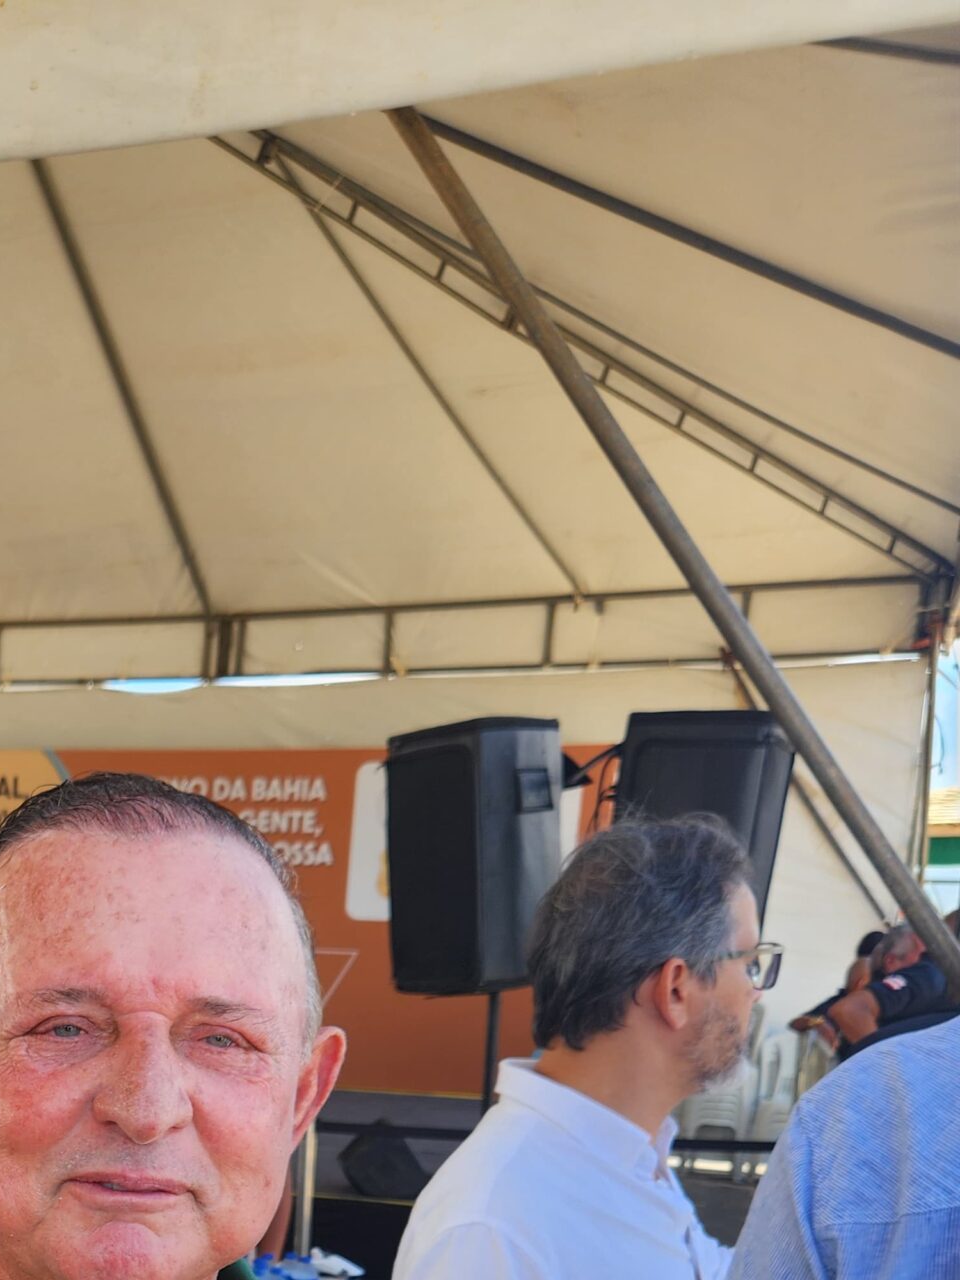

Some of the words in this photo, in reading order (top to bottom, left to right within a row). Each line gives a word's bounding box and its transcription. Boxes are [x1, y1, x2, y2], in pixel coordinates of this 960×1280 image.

[212, 777, 246, 801] DA
[251, 777, 327, 801] BAHIA
[271, 841, 334, 866] OSSA
